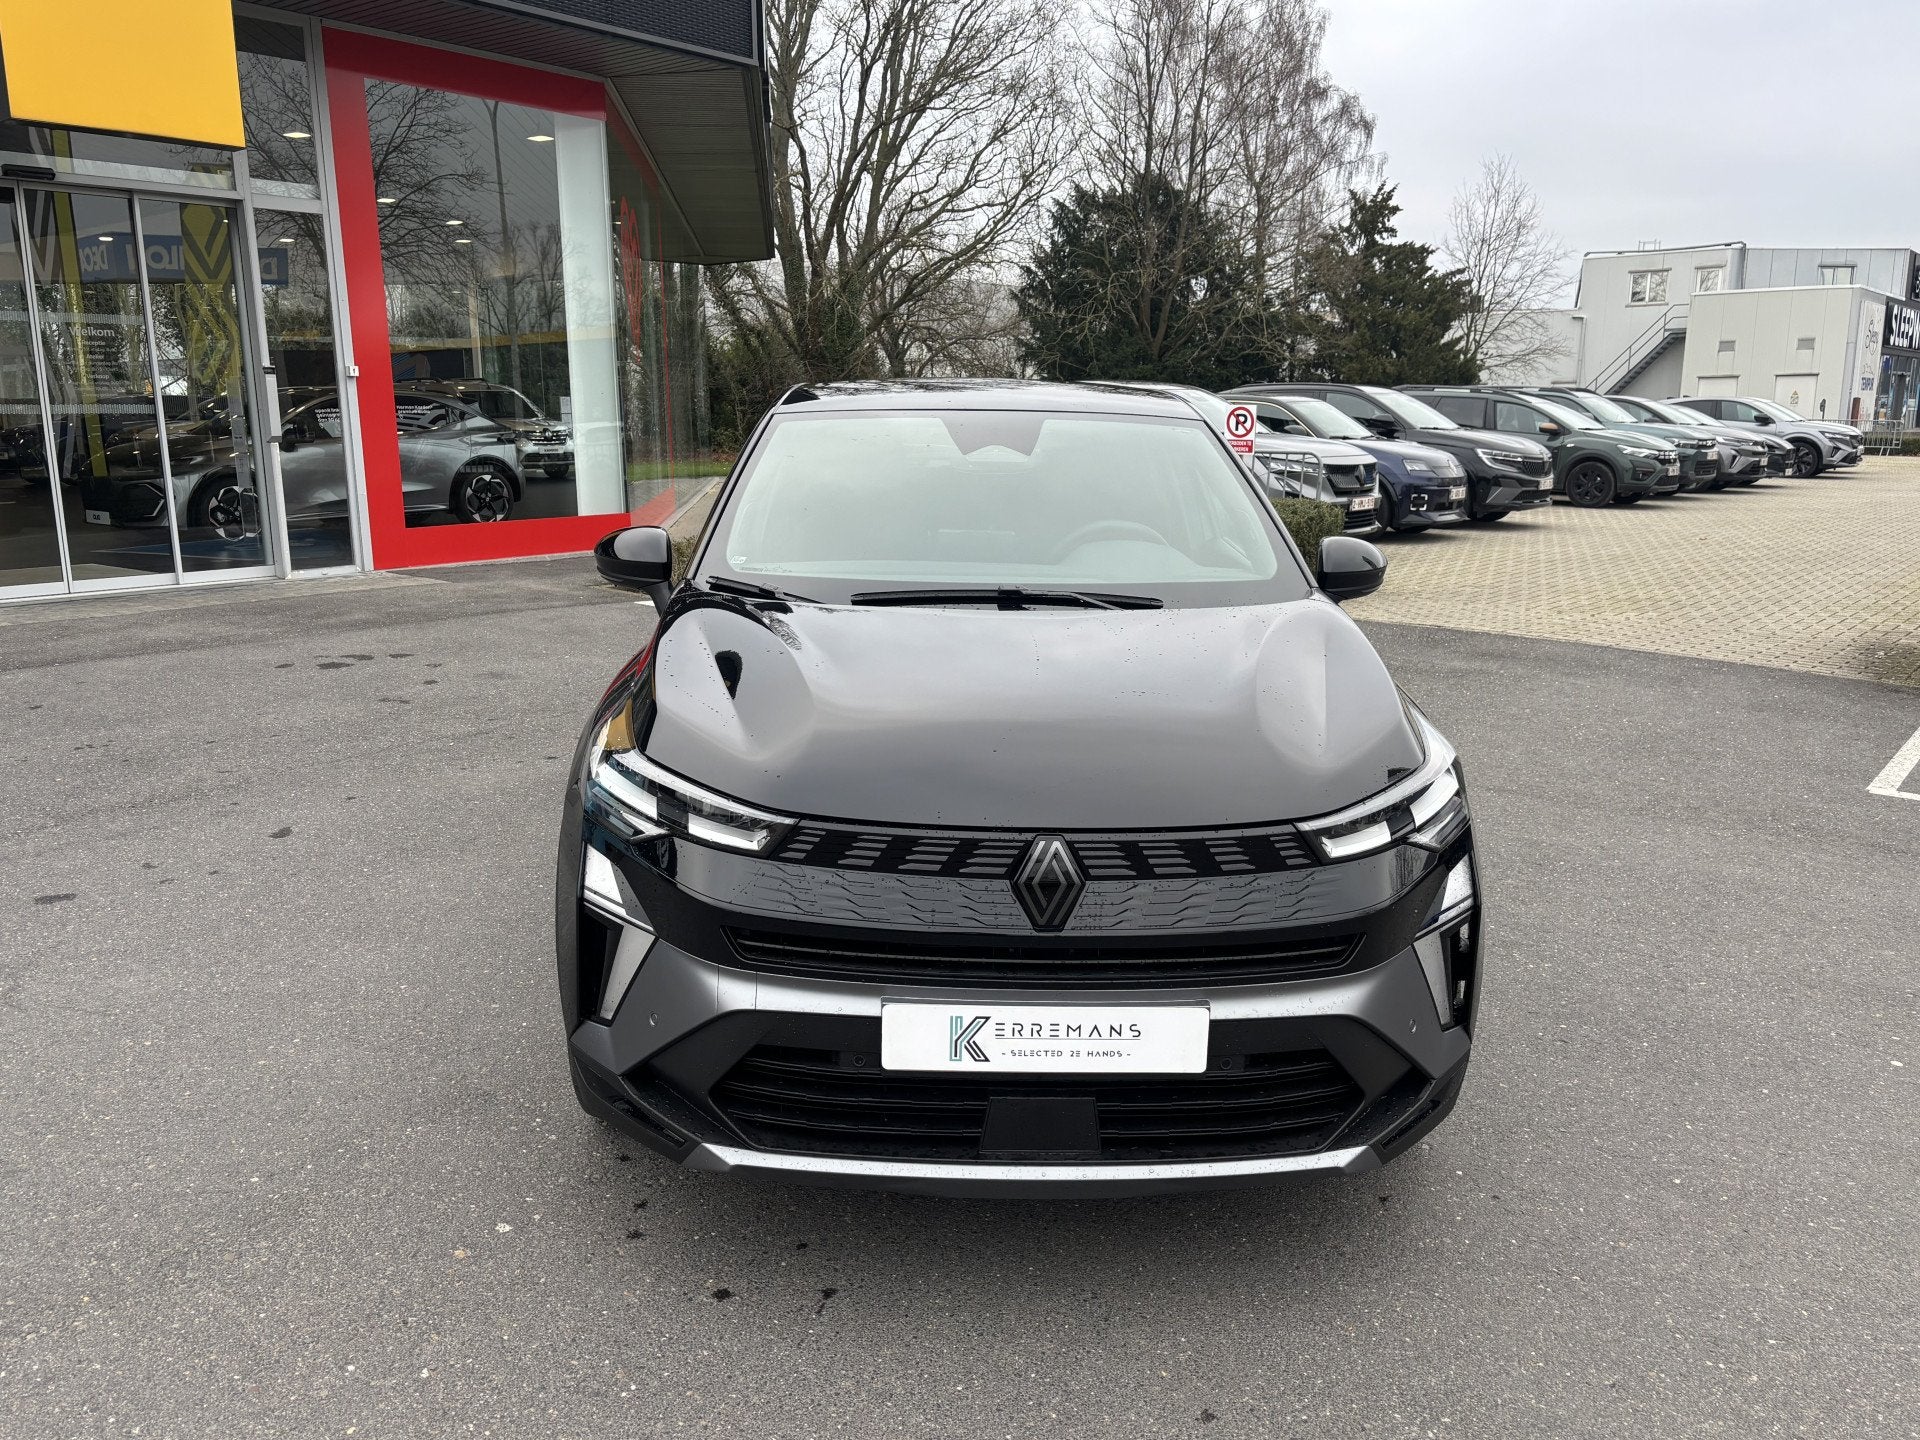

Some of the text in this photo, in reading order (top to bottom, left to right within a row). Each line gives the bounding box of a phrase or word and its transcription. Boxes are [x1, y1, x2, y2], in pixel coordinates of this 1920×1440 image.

[68, 326, 116, 337] Welkom
[1010, 1050, 1123, 1058] SELECTED 2E HANDS
